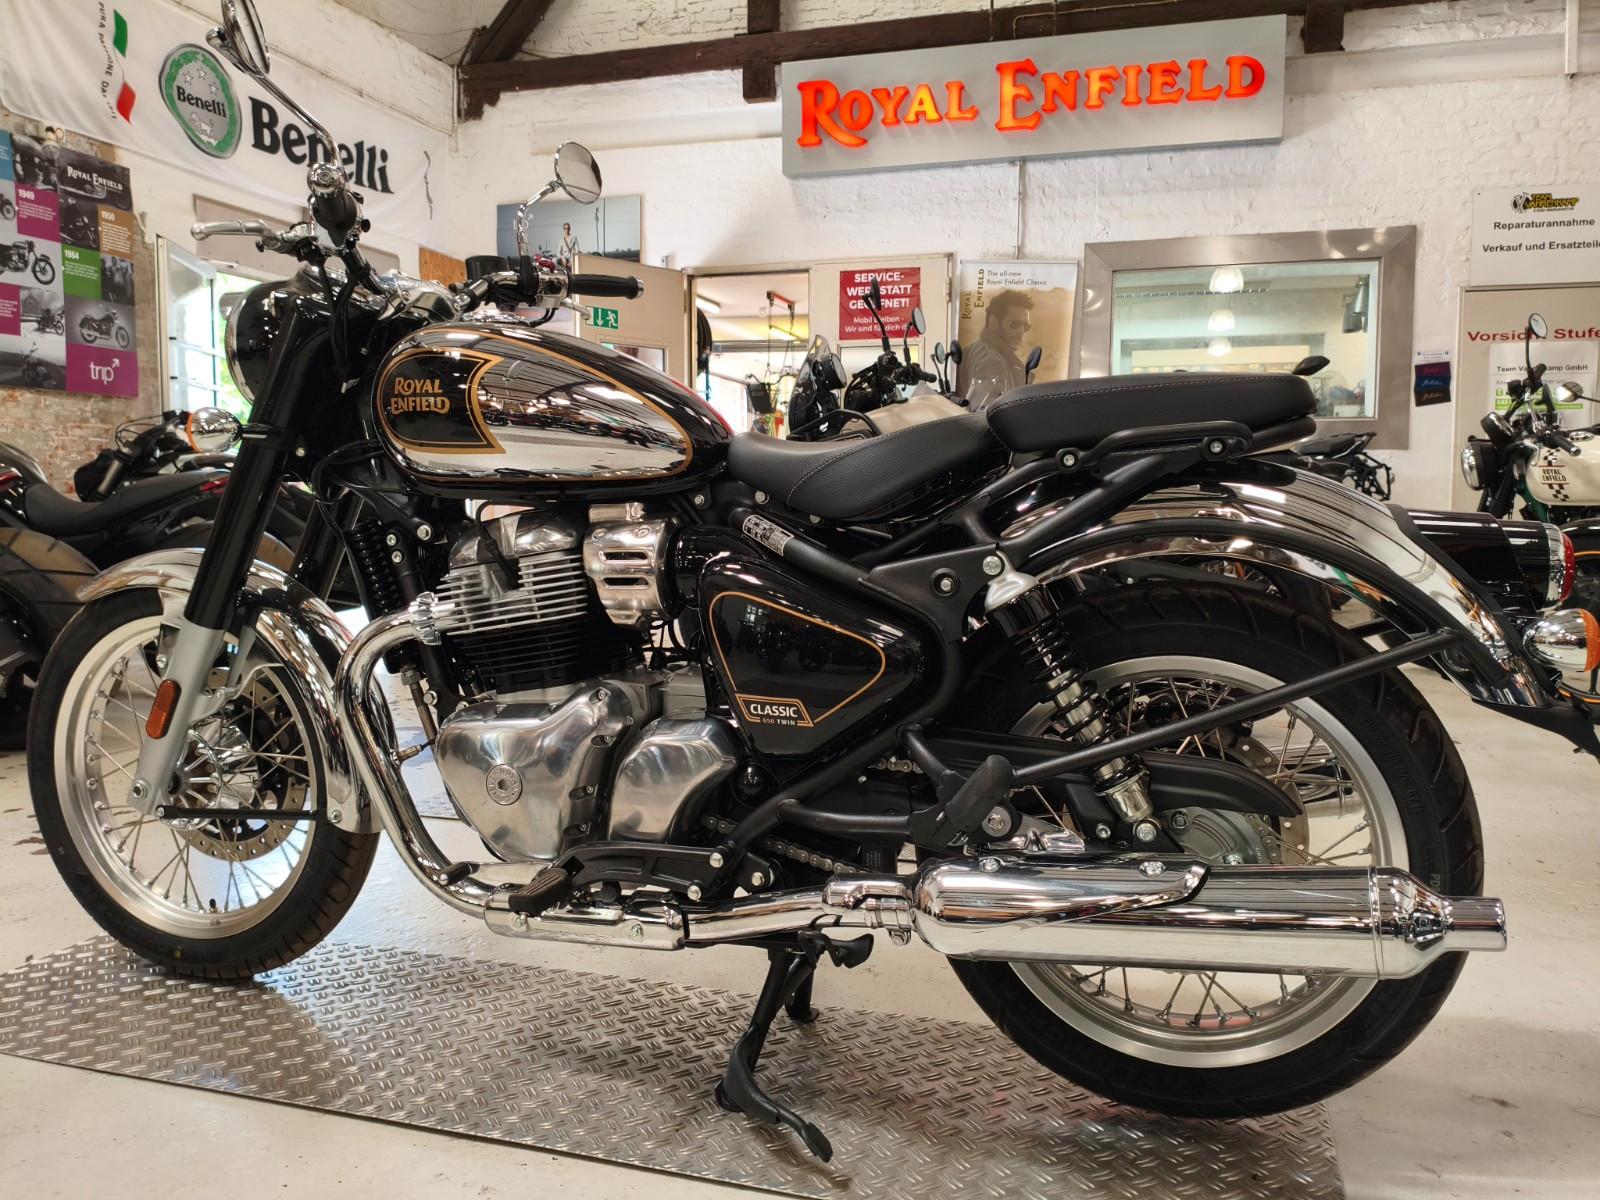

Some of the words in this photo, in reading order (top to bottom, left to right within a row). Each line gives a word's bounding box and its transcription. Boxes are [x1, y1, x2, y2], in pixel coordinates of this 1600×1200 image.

[176, 86, 227, 118] Benelli
[797, 79, 978, 147] ROYAL
[995, 54, 1266, 132] ENFIELD
[248, 96, 395, 195] Benelli
[67, 165, 92, 181] ROYAL
[92, 173, 123, 190] ENFIELD
[1493, 218, 1596, 231] Reparaturannahme
[1482, 242, 1523, 253] Verkauf
[1525, 242, 1546, 251] und
[1548, 240, 1600, 250] Ersatzteil
[846, 284, 913, 297] WERSTATT
[974, 268, 985, 308] ENFIELD
[986, 279, 1003, 287] Royal
[961, 290, 972, 320] ROYAL
[845, 325, 857, 333] Wir
[858, 323, 873, 332] sind
[853, 315, 873, 324] Mobil
[89, 361, 115, 385] trip
[1565, 364, 1588, 372] GmbH
[394, 377, 443, 396] ROYAL
[391, 396, 451, 415] ENFIELD
[750, 703, 798, 718] CLASSIC
[777, 718, 796, 726] TWIN
